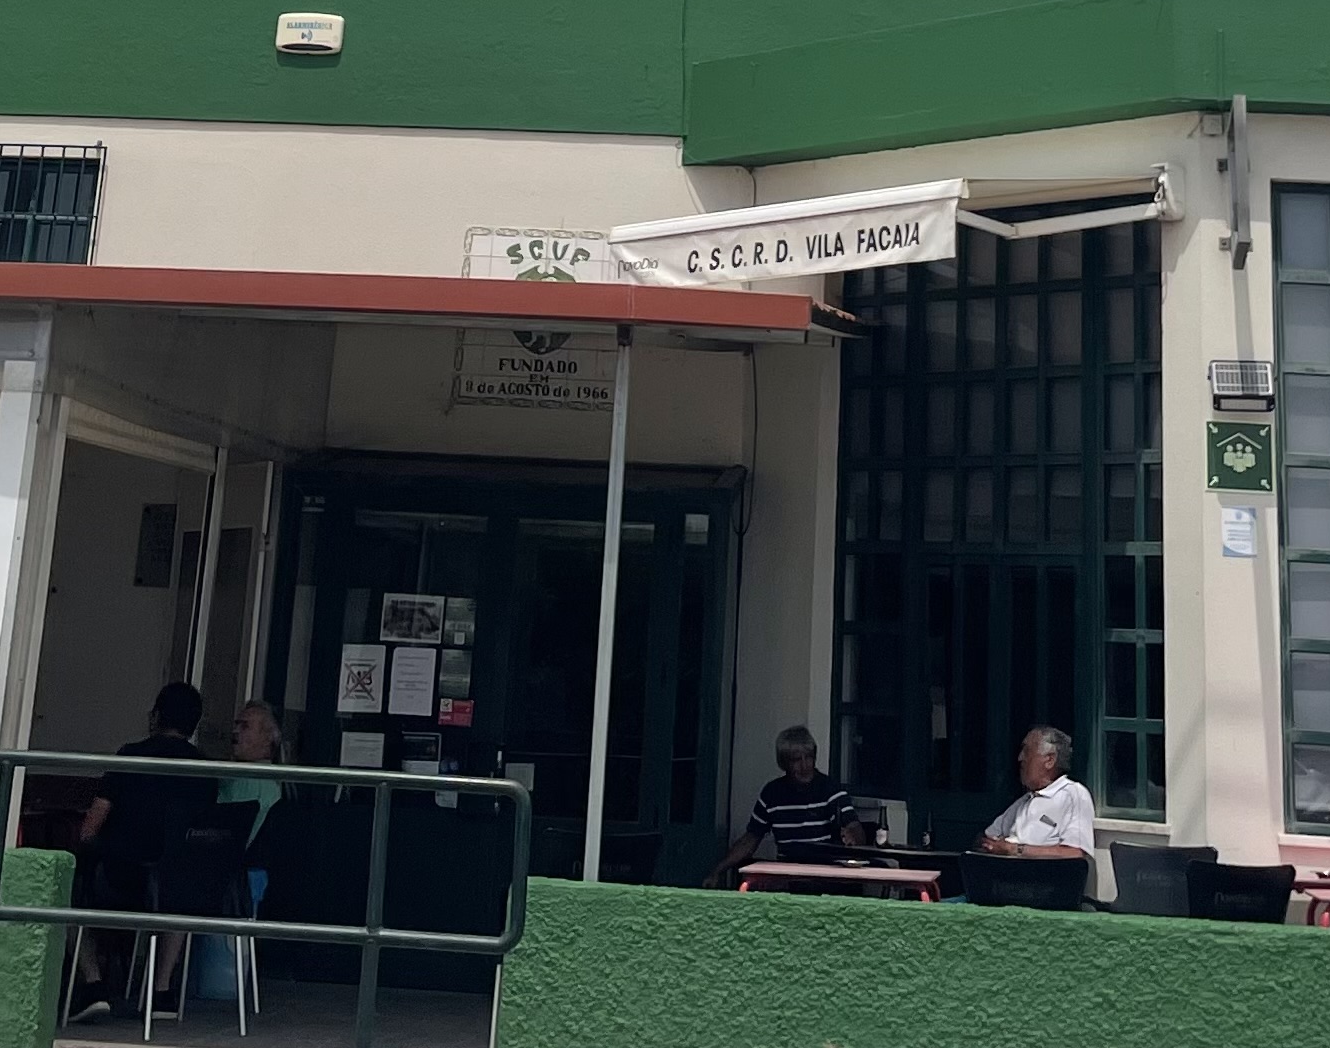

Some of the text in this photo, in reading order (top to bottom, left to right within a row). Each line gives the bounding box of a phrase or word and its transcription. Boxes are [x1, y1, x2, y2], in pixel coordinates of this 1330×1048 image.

[805, 232, 845, 259] VILA
[857, 222, 920, 254] FACAIA
[498, 358, 578, 374] FUNDADO
[498, 382, 551, 397] AGOSTO
[576, 386, 609, 399] 1966
